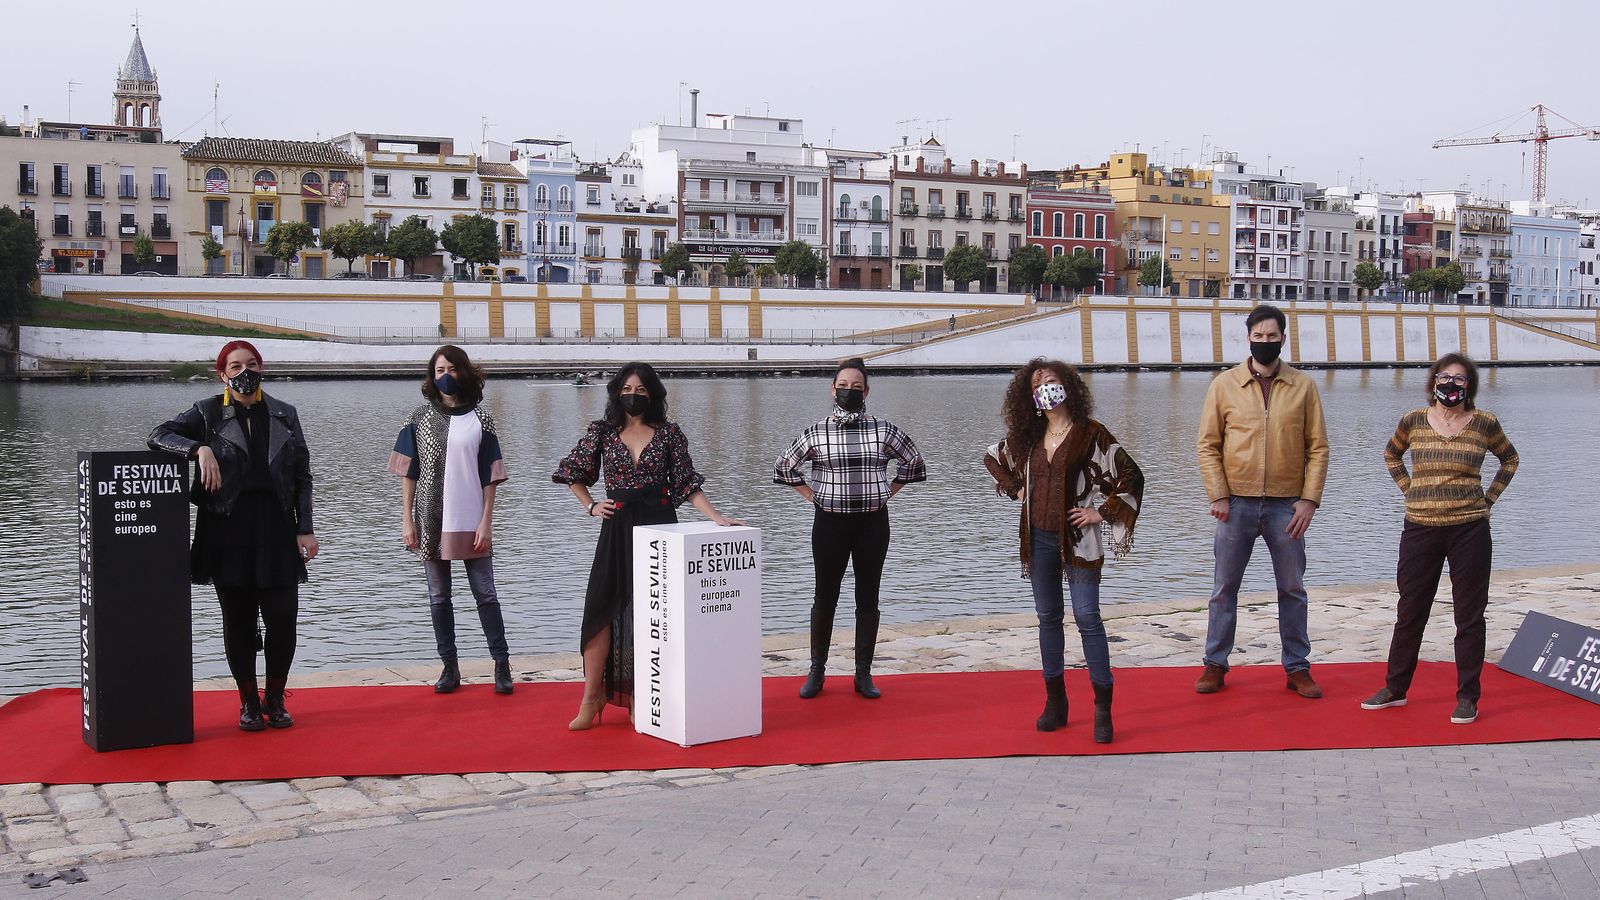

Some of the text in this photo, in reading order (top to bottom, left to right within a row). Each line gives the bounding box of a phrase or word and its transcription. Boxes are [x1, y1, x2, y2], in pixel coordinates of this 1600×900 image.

[113, 464, 181, 479] FESTIVAL
[99, 480, 181, 495] DE SEVILLA
[114, 500, 152, 509] esto es
[114, 511, 137, 522] cine
[114, 524, 157, 535] europeo
[701, 541, 756, 557] FESTIVAL
[688, 556, 756, 574] DE SEVILLA
[701, 577, 727, 587] this is
[79, 460, 90, 730] FESTIVAL DE SEVILLA
[701, 589, 740, 601] european
[663, 608, 667, 618] es
[701, 603, 732, 613] cinema
[650, 540, 661, 727] FESTIVAL DE SEVILLA
[1548, 656, 1576, 682] DE
[1571, 664, 1600, 694] SEV
